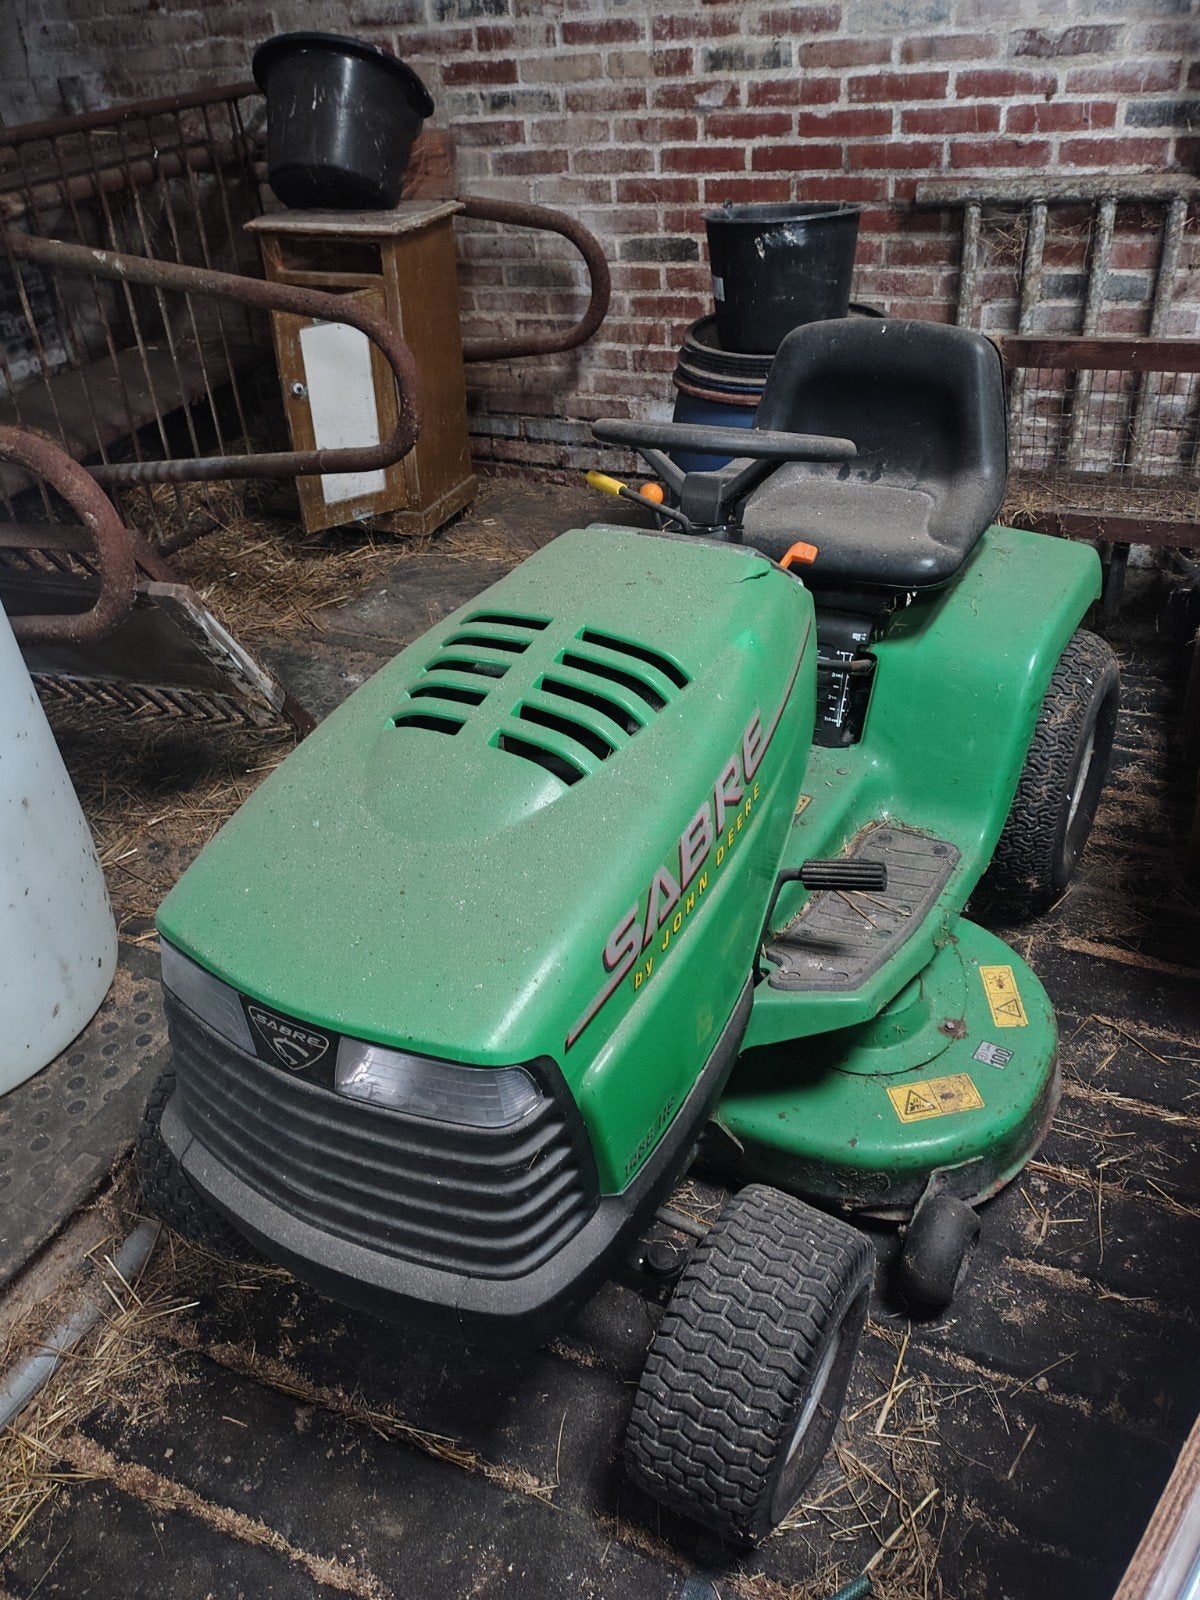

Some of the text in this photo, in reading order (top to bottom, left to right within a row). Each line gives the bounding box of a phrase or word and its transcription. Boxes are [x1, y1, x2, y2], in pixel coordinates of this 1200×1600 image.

[603, 705, 765, 973] SABRE
[634, 781, 761, 991] by JOHN DEERE
[256, 1013, 320, 1046] SABRE
[990, 1048, 1011, 1067] 100
